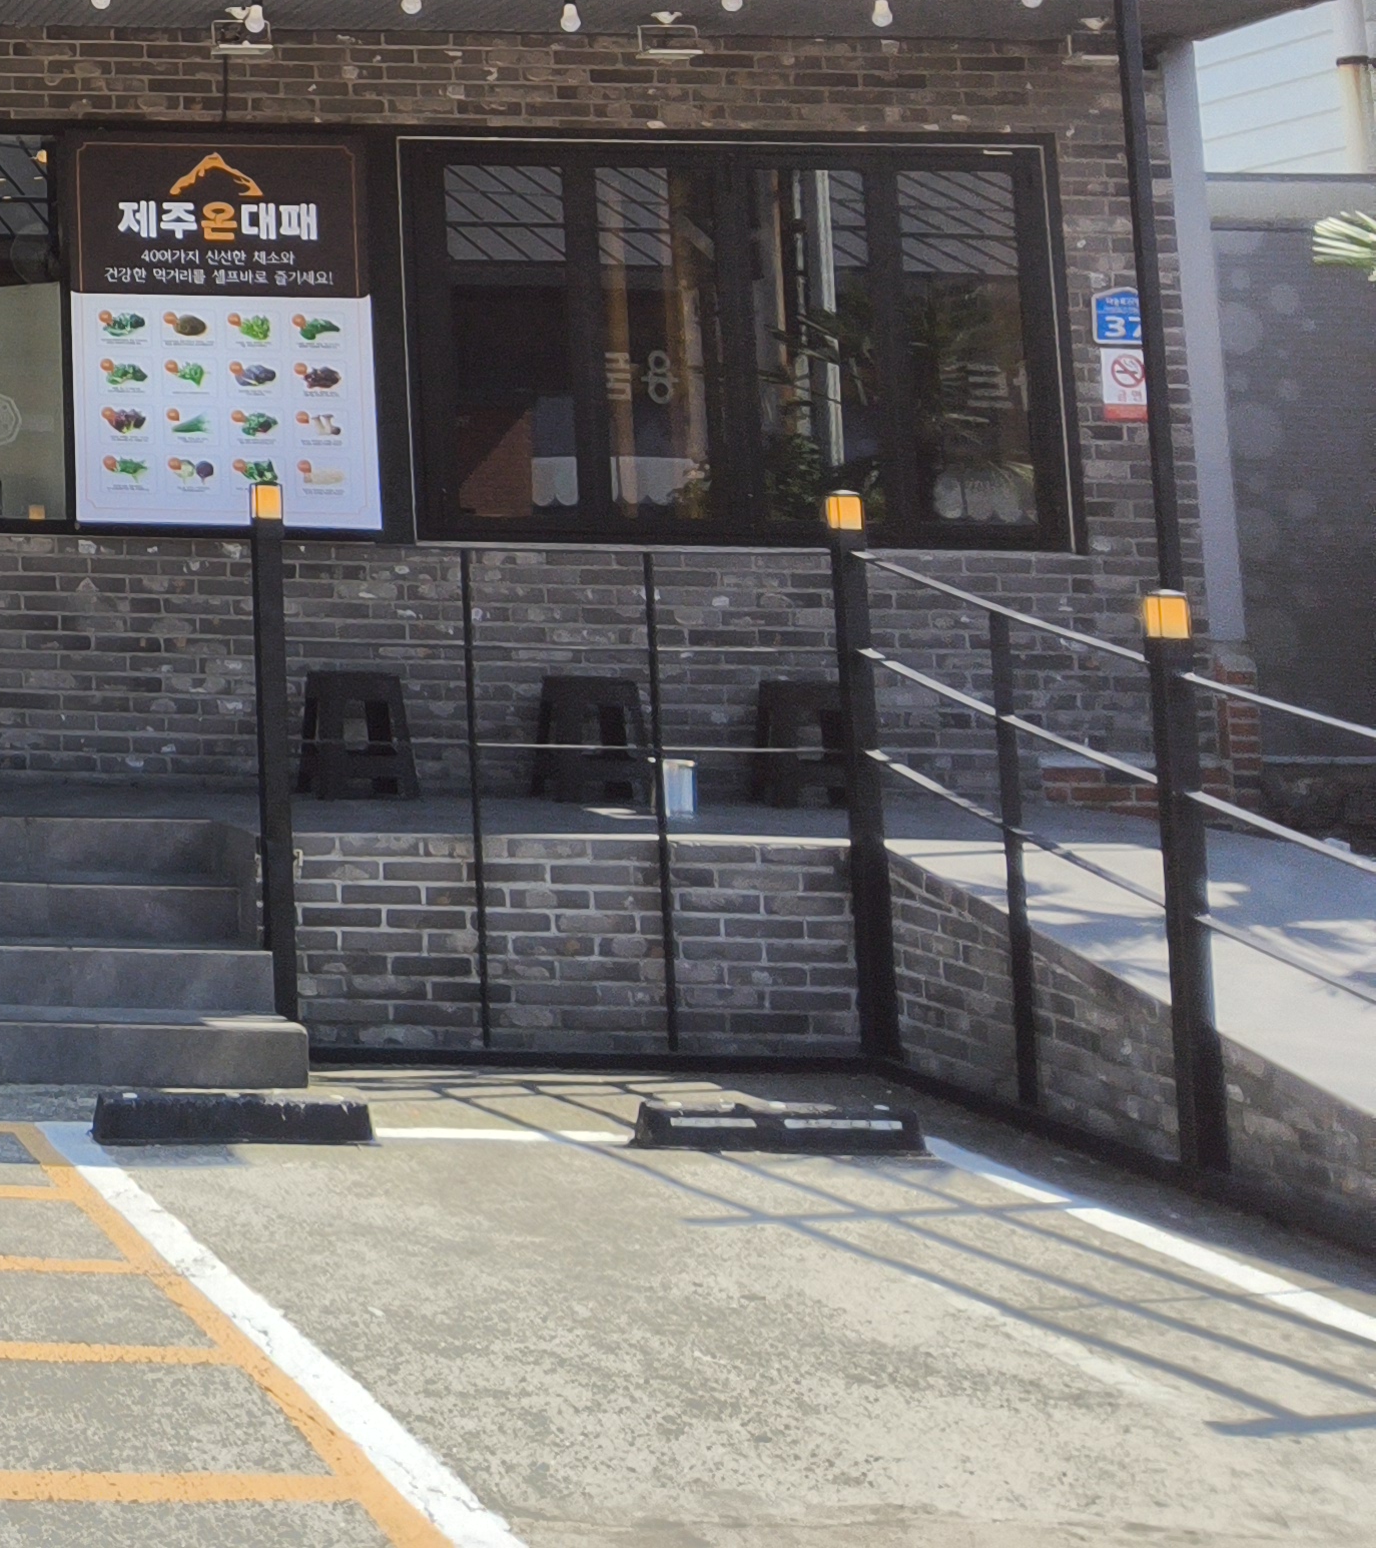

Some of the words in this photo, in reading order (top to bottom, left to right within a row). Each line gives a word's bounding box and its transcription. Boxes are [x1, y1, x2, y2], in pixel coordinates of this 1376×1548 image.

[117, 200, 318, 241] 제주온대패
[140, 249, 200, 265] 40여가지
[205, 249, 247, 265] 신선한
[252, 251, 296, 266] 채소와
[104, 266, 148, 283] 건강한
[152, 268, 207, 285] 먹거리를
[211, 269, 269, 285] 셀프바로
